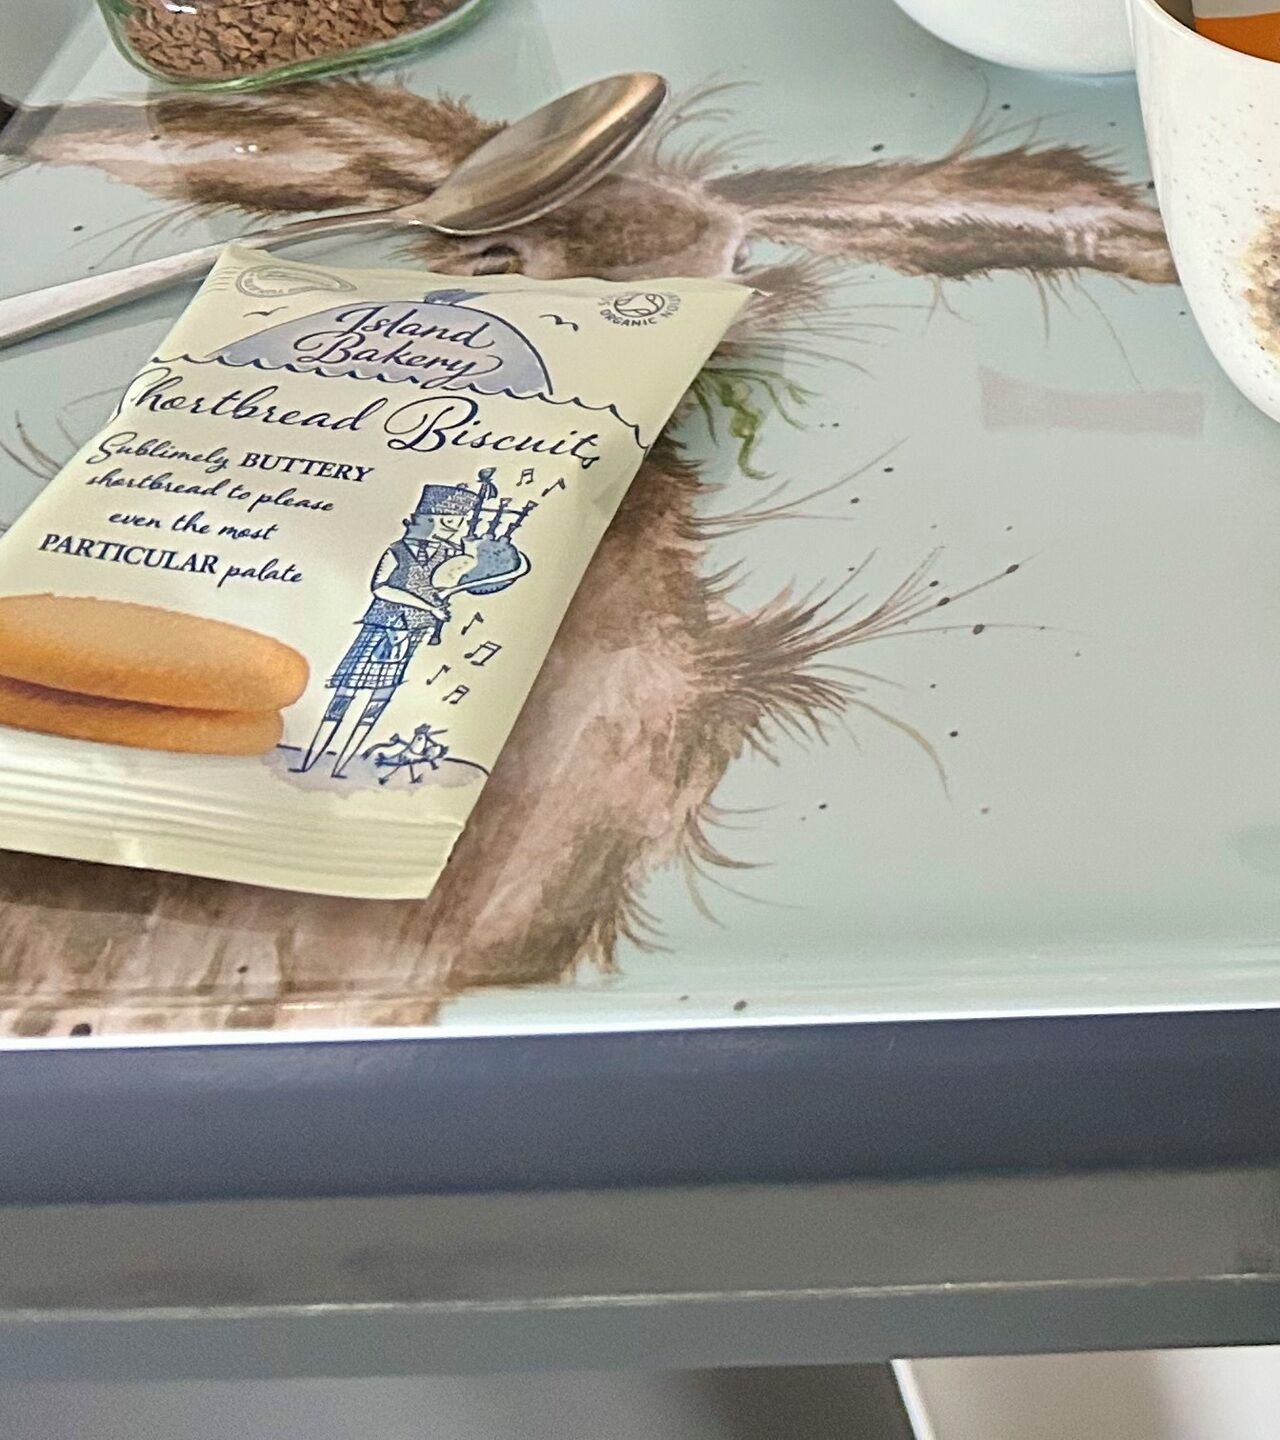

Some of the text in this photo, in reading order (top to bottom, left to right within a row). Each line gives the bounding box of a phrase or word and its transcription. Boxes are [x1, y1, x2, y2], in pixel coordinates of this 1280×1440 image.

[335, 305, 495, 349] Island
[600, 308, 657, 326] ORGANIC
[293, 330, 505, 390] Bakery
[383, 395, 600, 467] Biscuits
[86, 431, 376, 482] Sublimely BUTTERY
[86, 468, 335, 512] shortbread to please
[109, 512, 279, 541] even the most
[38, 533, 302, 588] PARTICULAR palate
